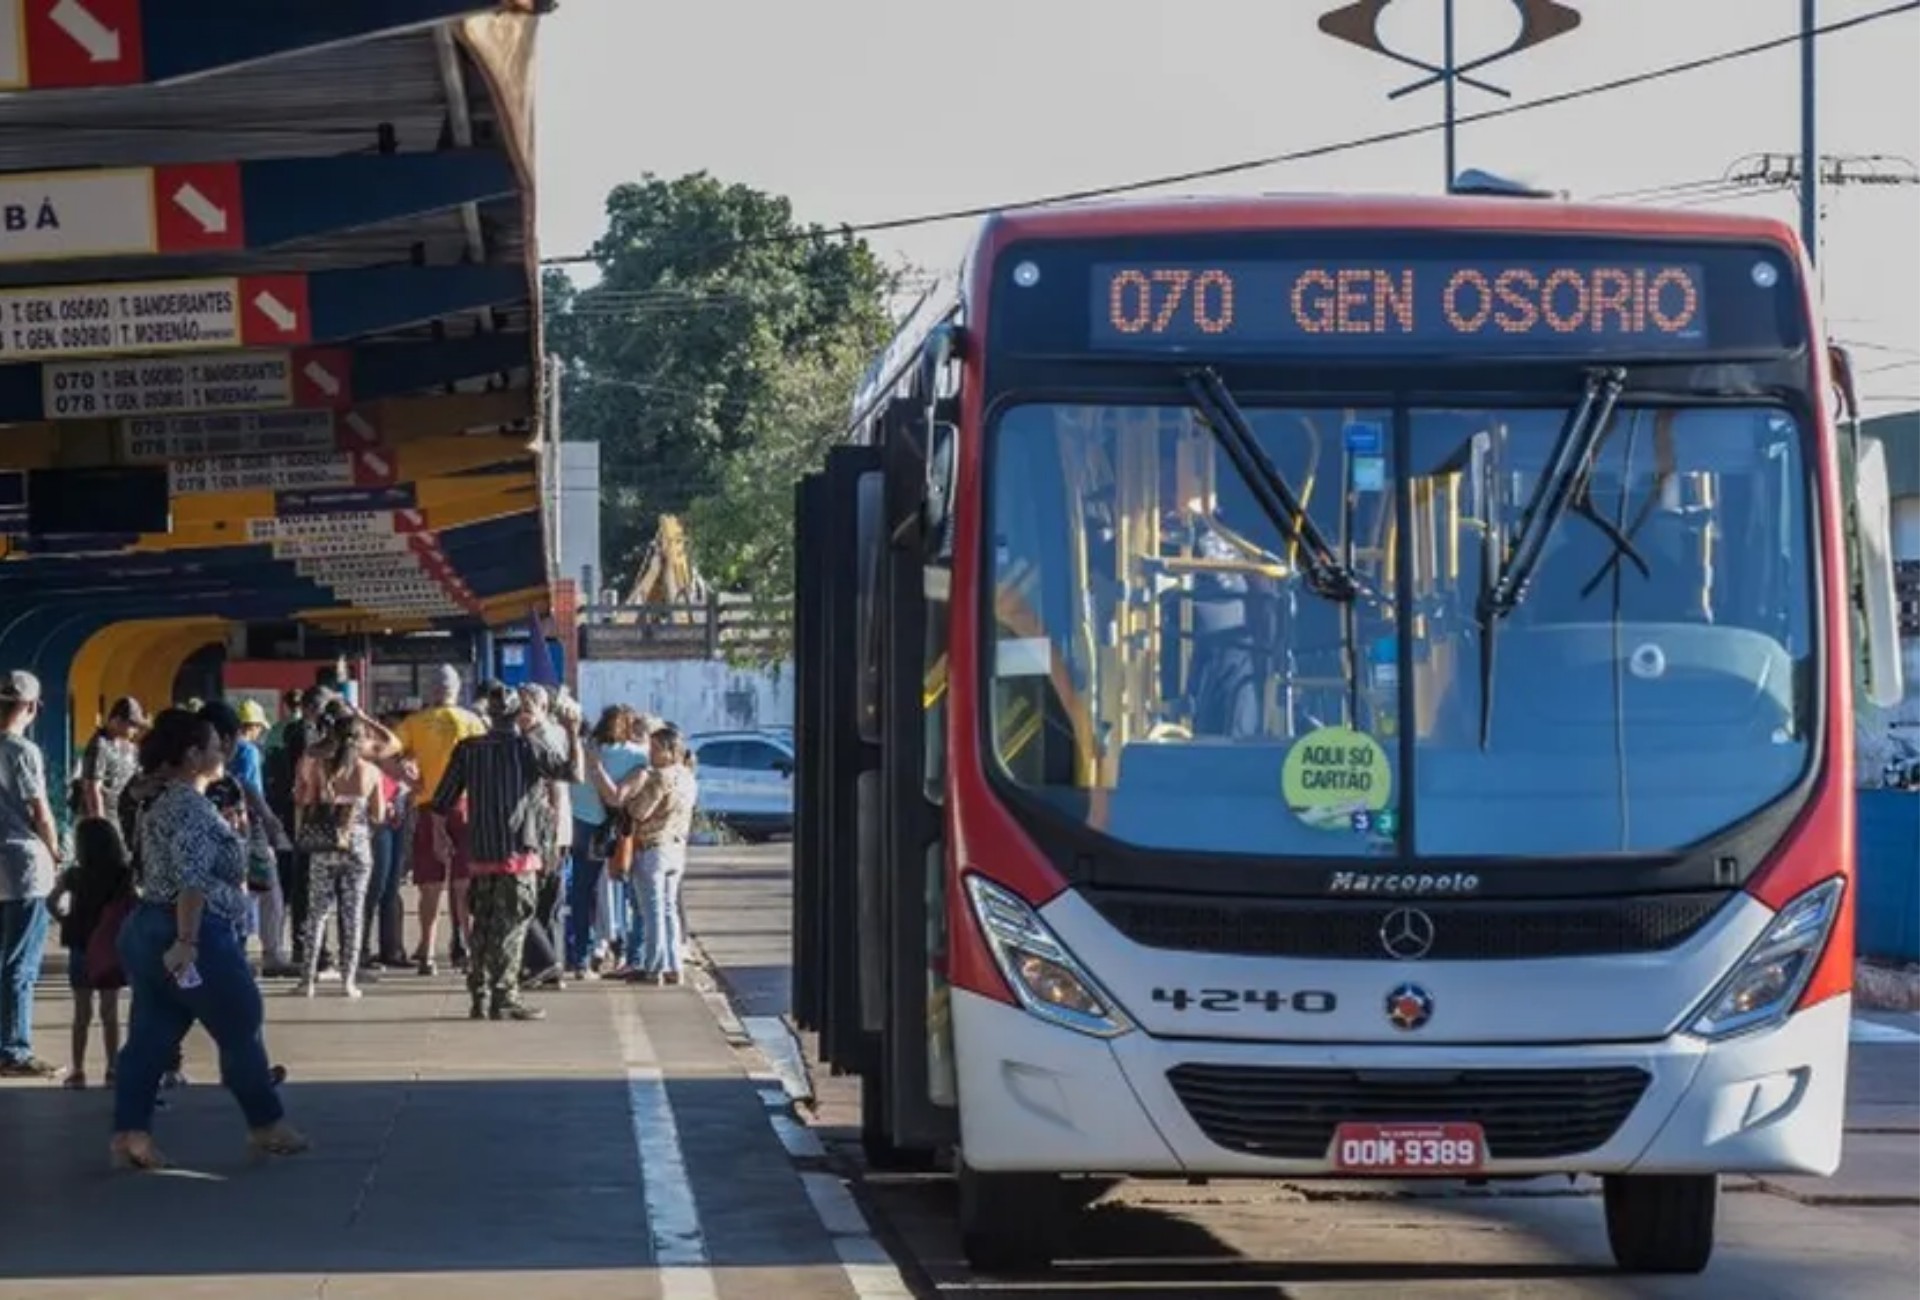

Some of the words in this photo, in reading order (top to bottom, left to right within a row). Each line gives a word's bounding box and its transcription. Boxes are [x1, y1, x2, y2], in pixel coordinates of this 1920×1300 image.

[133, 291, 232, 317] BANDEIRANTES
[1110, 269, 1232, 332] 070
[1291, 269, 1413, 332] GEN
[1442, 268, 1696, 332] OSORIO
[54, 371, 95, 389] 070
[1302, 745, 1345, 766] AQUI
[1301, 767, 1372, 791] CARTÃO
[1329, 870, 1480, 893] Marcopolo
[1151, 988, 1337, 1014] 4240
